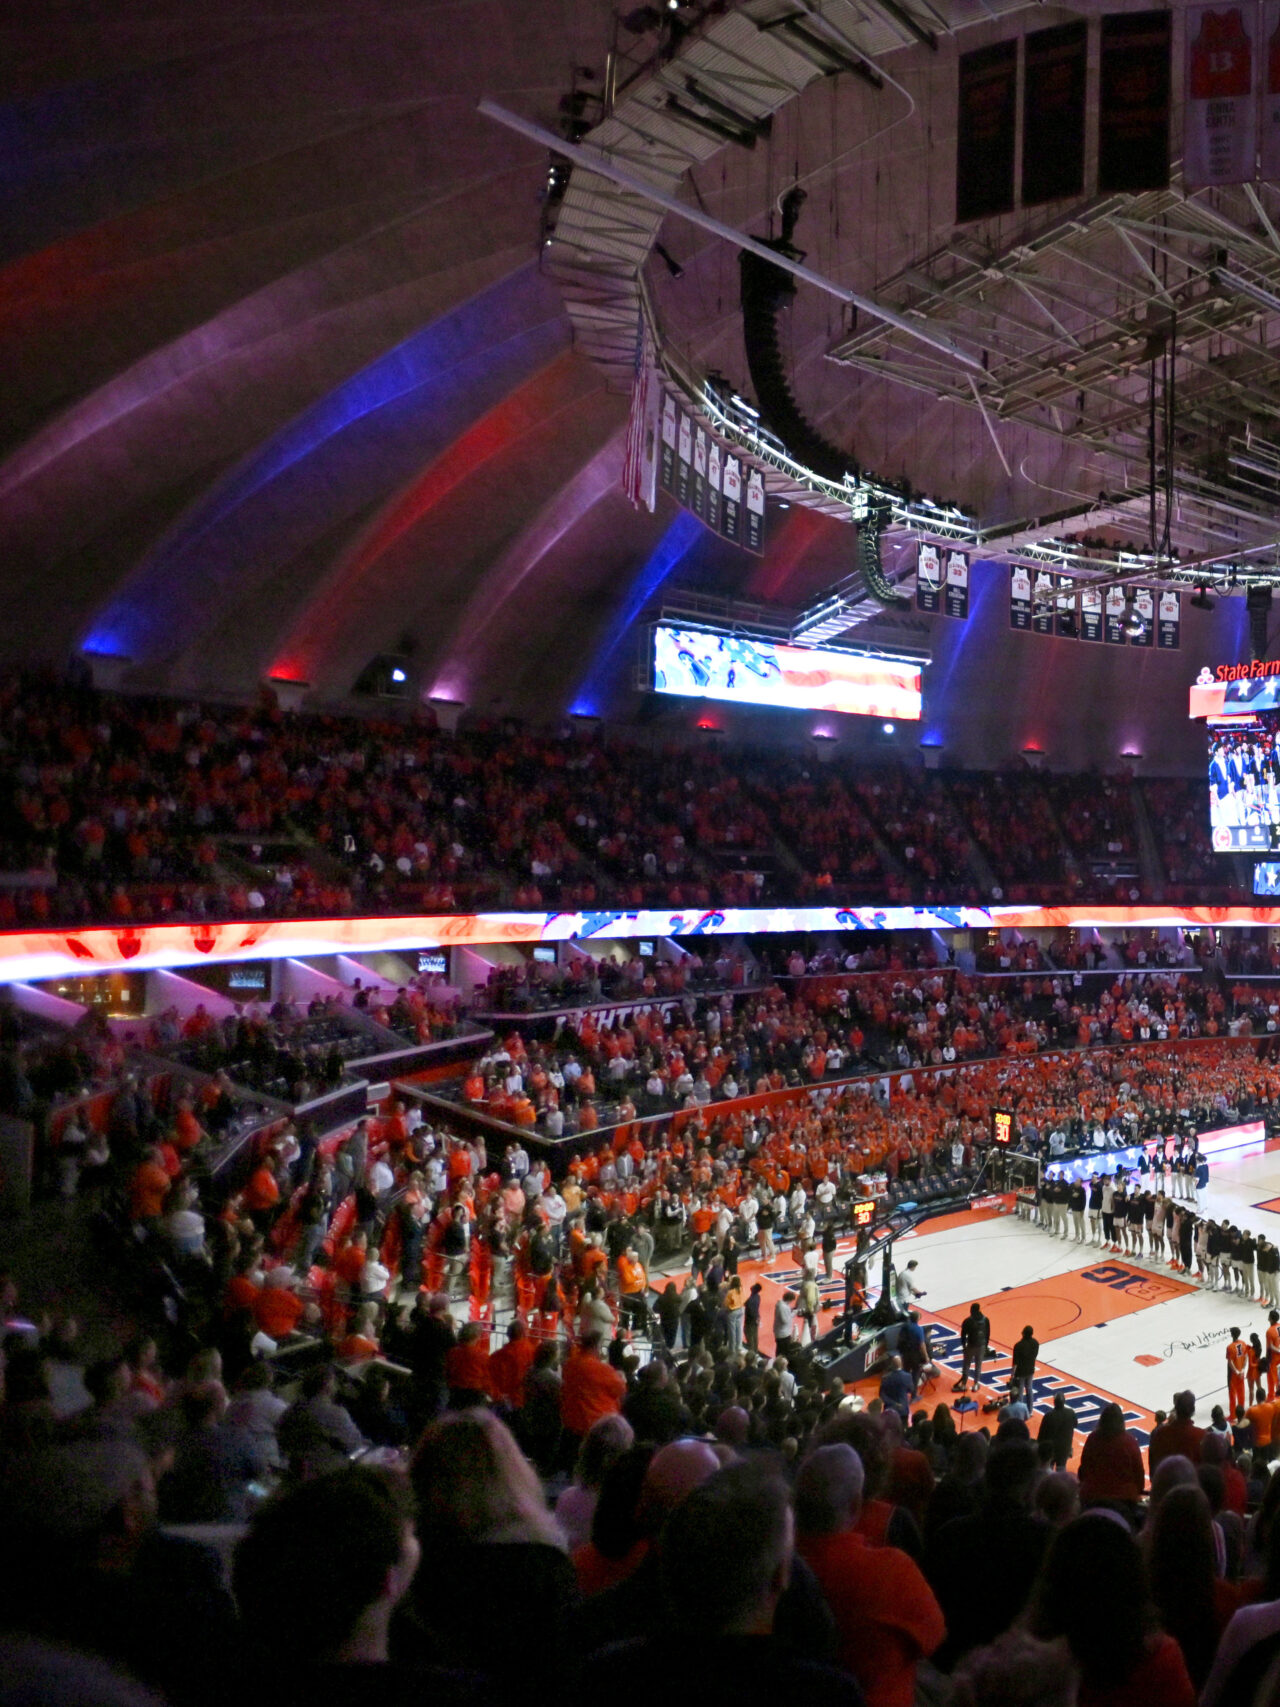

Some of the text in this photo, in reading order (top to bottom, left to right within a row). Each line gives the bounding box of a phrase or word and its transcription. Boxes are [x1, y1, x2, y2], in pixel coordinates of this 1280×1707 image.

[1208, 51, 1233, 73] 13
[996, 1124, 1009, 1142] 30
[854, 1202, 875, 1215] 20:00
[857, 1212, 871, 1226] 30
